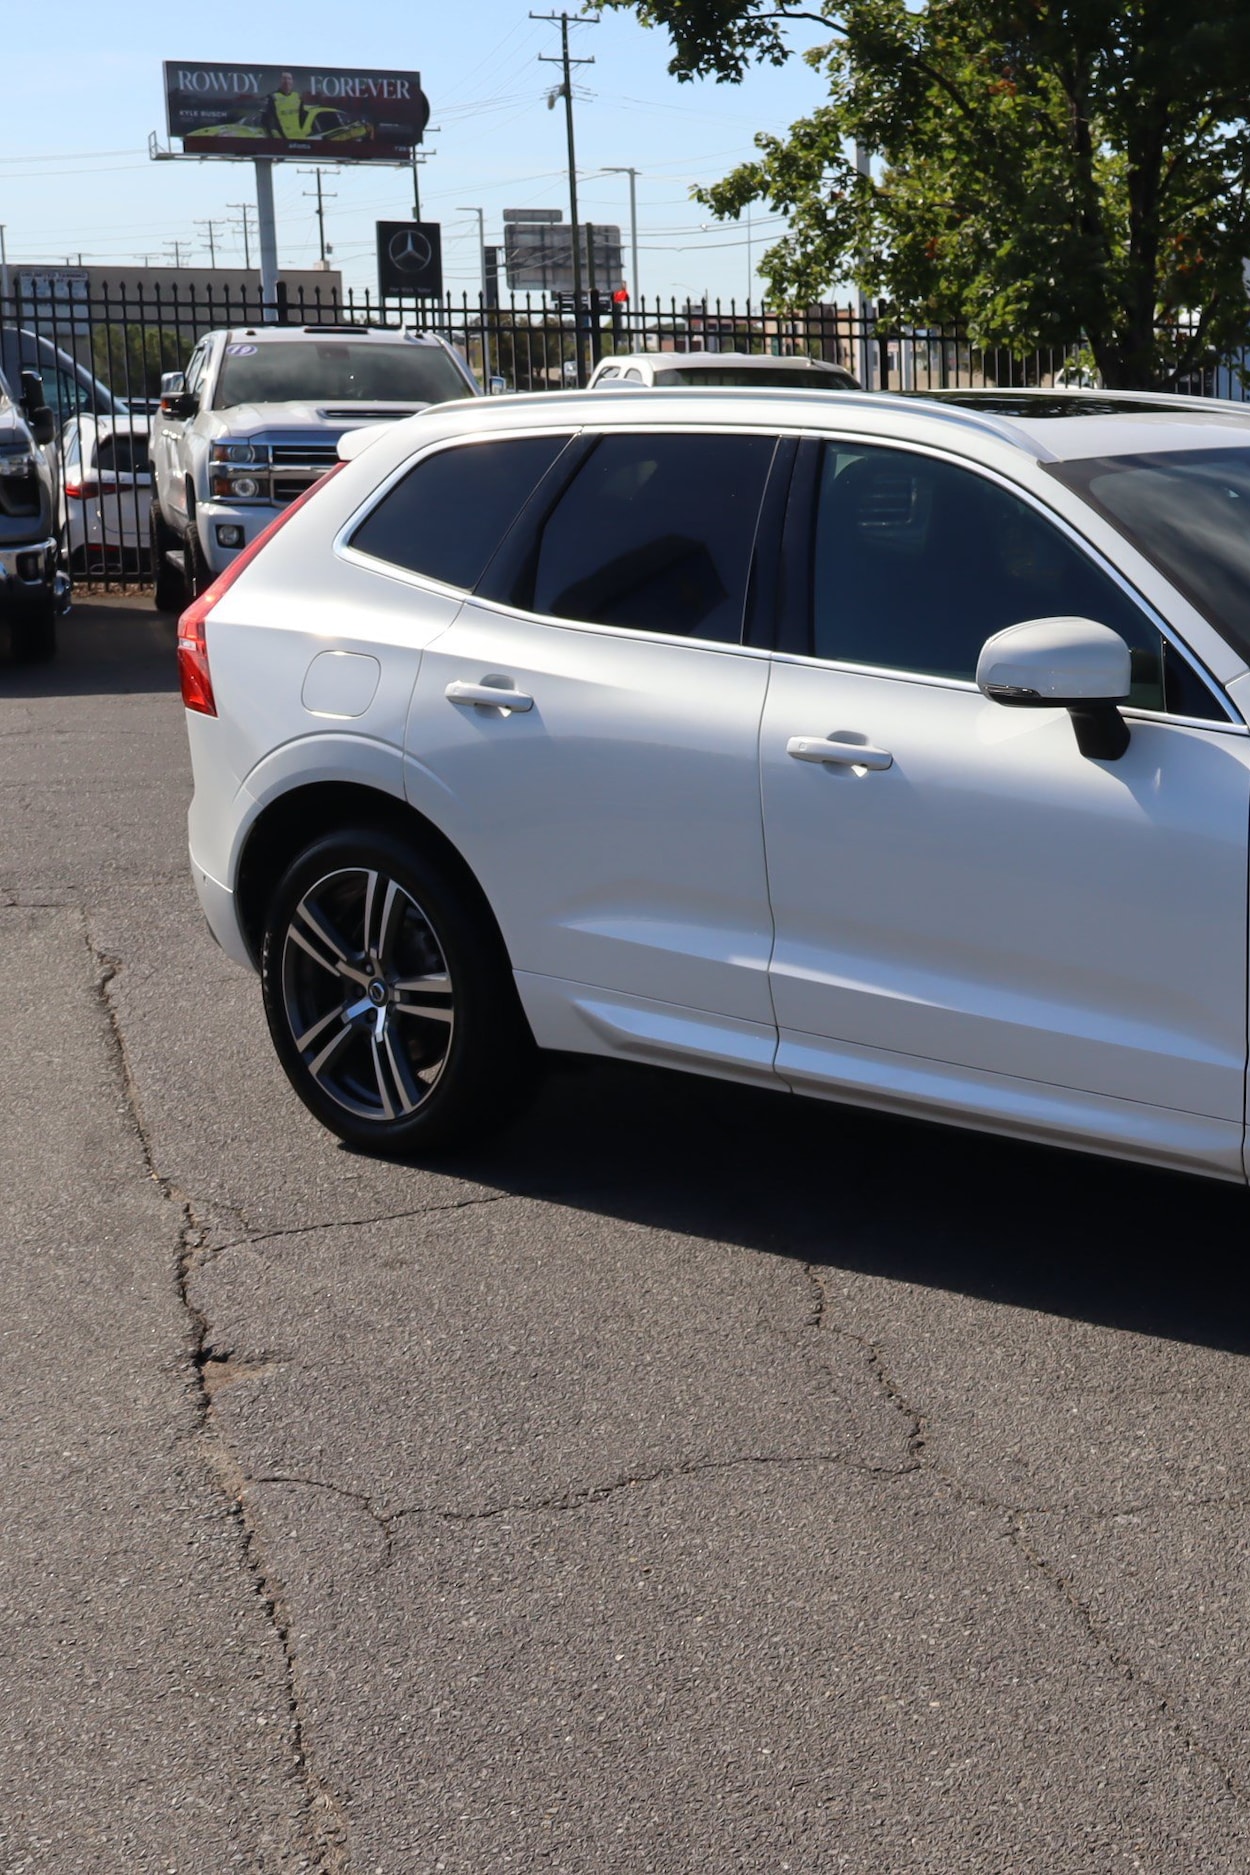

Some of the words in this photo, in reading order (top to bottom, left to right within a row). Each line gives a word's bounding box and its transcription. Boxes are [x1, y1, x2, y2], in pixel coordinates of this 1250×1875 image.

[177, 70, 263, 94] ROWDY
[310, 75, 411, 100] FOREVER
[200, 110, 227, 118] BUSCH
